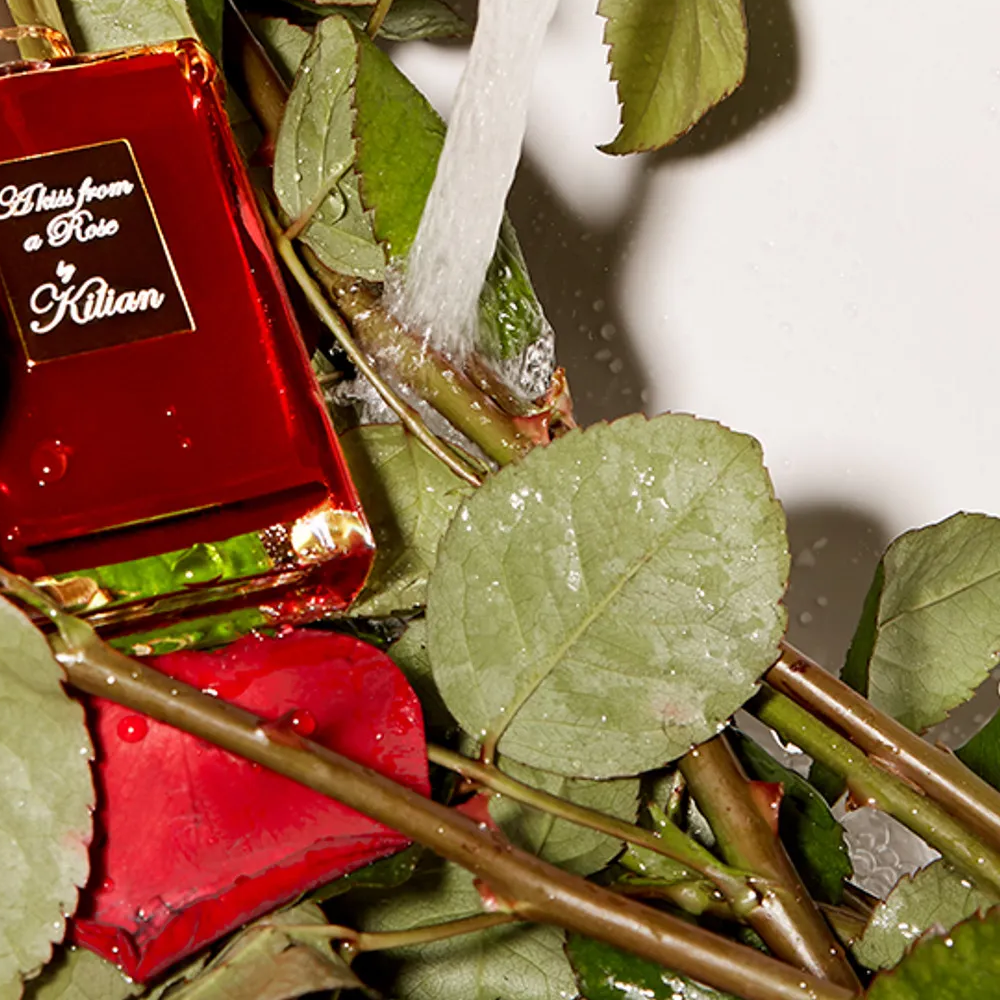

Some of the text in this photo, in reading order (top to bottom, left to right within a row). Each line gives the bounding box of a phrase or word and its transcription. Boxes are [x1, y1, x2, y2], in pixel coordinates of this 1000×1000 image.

[35, 185, 75, 212] kiss
[73, 176, 134, 210] from
[23, 209, 119, 252] a Rose
[56, 260, 76, 284] by
[30, 276, 165, 333] Kilian
